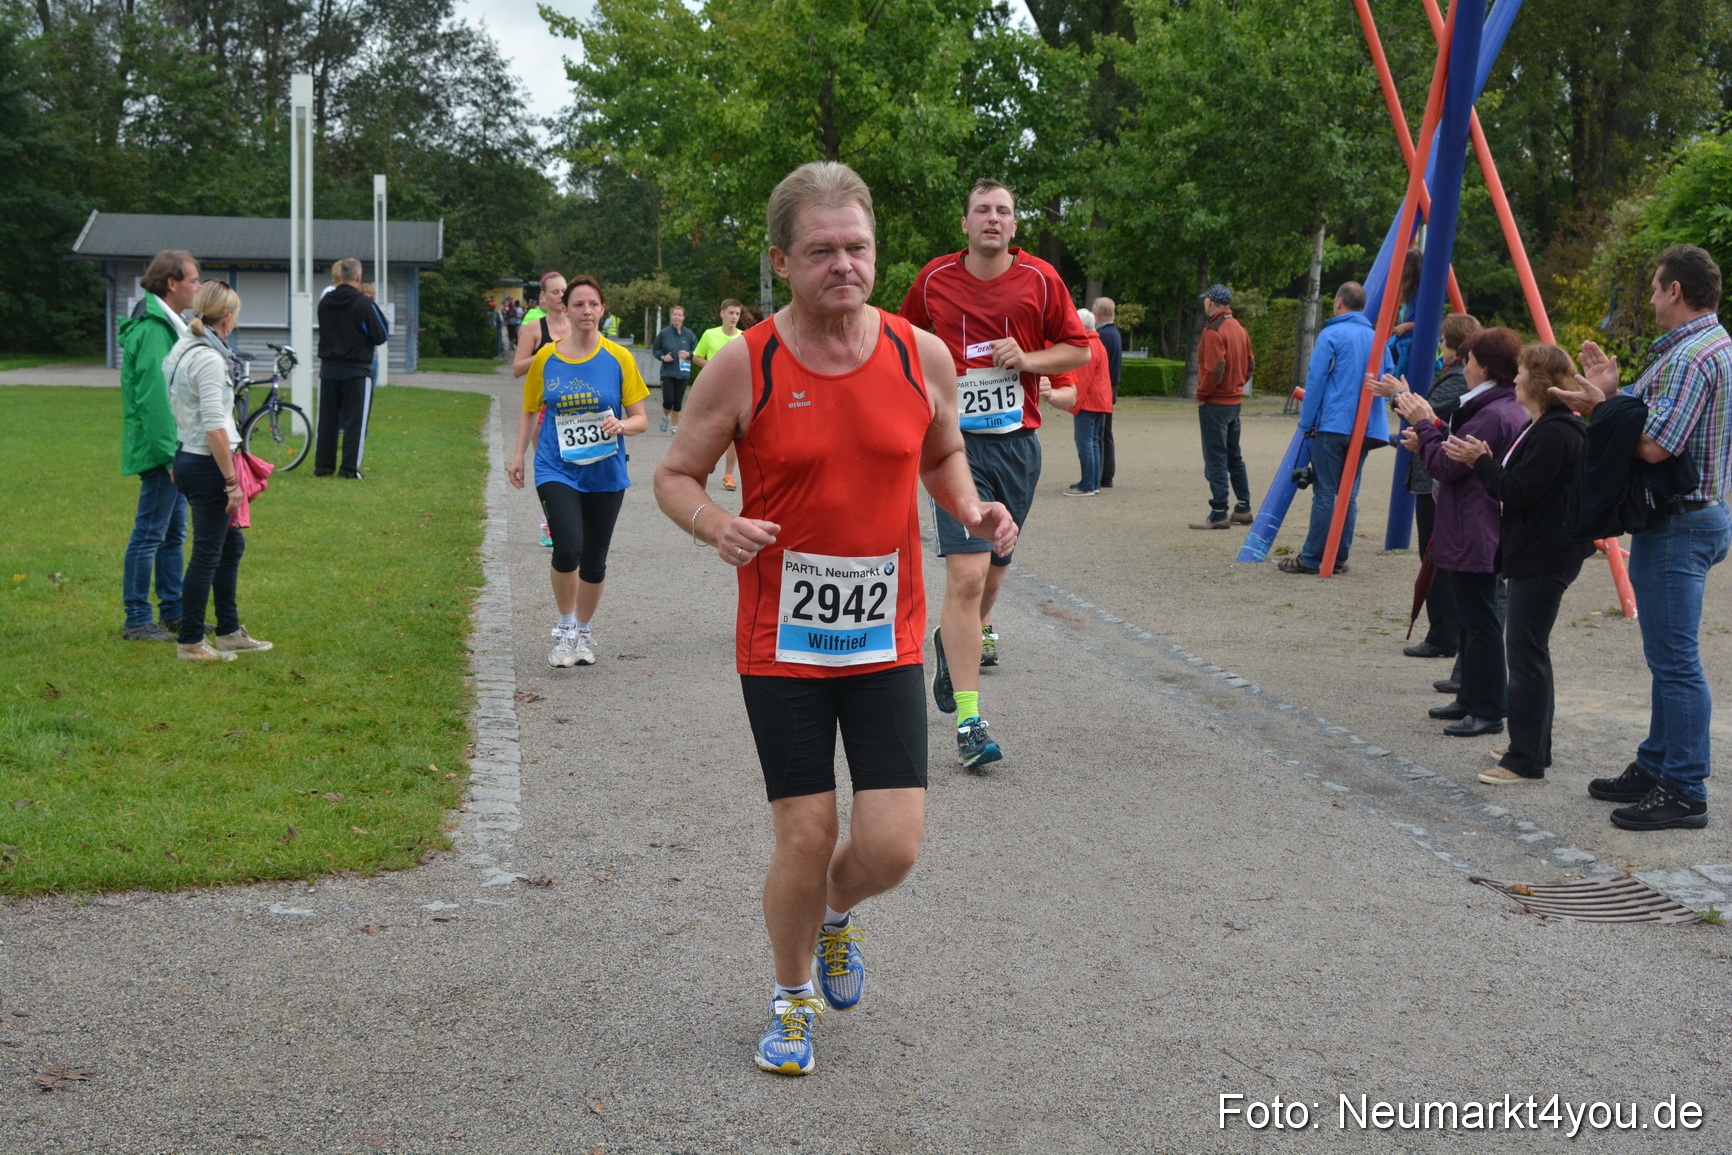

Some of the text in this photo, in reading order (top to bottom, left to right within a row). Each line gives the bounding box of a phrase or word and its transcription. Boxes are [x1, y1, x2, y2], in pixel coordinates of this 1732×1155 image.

[957, 376, 1011, 388] PARTL Neumarkt
[963, 385, 1016, 414] 2515
[557, 416, 605, 427] PARTL Neumarkt
[984, 417, 1003, 427] Tim
[785, 561, 881, 579] PARTL Neumarkt
[792, 580, 888, 624] 2942
[808, 632, 868, 651] Wilfried
